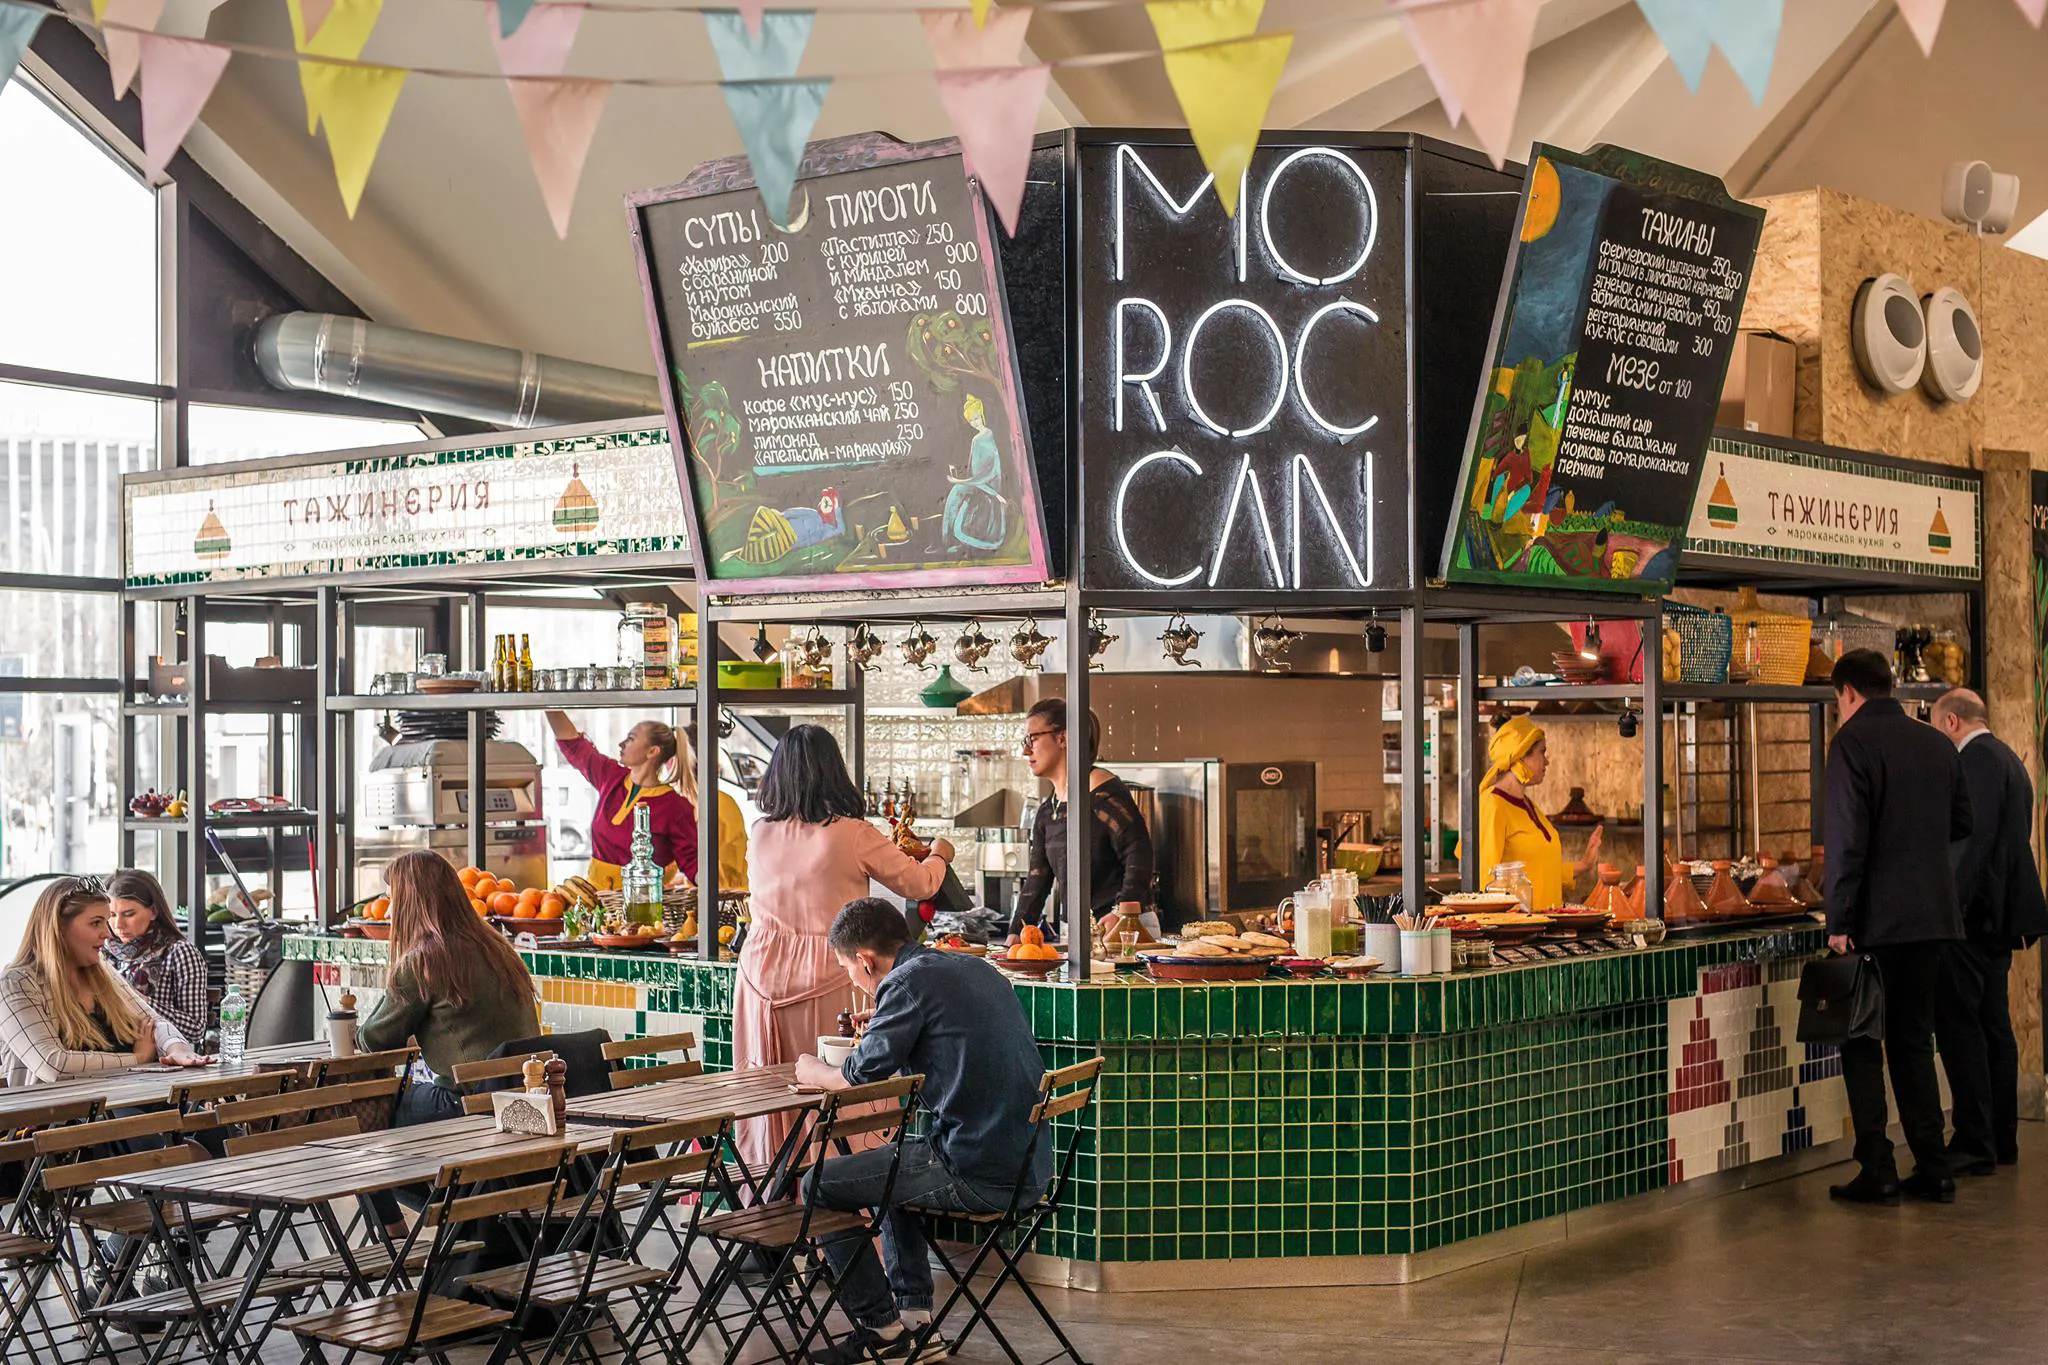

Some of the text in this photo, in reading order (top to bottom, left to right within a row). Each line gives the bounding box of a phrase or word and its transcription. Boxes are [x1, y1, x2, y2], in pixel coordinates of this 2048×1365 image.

[825, 180, 937, 229] ПИРОГИ
[684, 209, 761, 249] СУПЫ
[925, 222, 953, 245] 250
[1641, 207, 1716, 257] ТАЖИНЫ
[760, 241, 789, 265] 200
[826, 241, 978, 271] с курицей 900
[1600, 239, 1731, 281] фермерский цыпленок 350
[682, 263, 778, 291] с бараниной
[829, 258, 930, 287] и миндалем
[933, 268, 962, 290] 150
[1593, 273, 1635, 296] ягненок
[1606, 258, 1639, 278] груши
[1645, 268, 1693, 292] лимонной
[1724, 269, 1743, 290] 650
[685, 284, 752, 306] и нутом
[838, 293, 987, 320] с яблоками 800
[1590, 288, 1654, 316] абрикосами
[1663, 305, 1703, 327] изюмом
[773, 310, 802, 331] 350
[1702, 298, 1721, 319] 450
[1587, 308, 1667, 337] вегетарианский
[1635, 334, 1680, 354] овощами
[1692, 335, 1714, 358] 300
[757, 342, 890, 389] НАПИТКИ
[1116, 297, 1379, 439] ROC
[887, 380, 914, 401] 150
[1572, 388, 1612, 409] хумус
[893, 401, 920, 420] 250
[1566, 404, 1654, 436] домашний сыр
[896, 423, 924, 441] 250
[1565, 424, 1678, 456] печеные баклажаны
[1560, 440, 1606, 463] морковь
[1557, 458, 1605, 480] перчики
[1116, 451, 1373, 590] CAN
[1786, 527, 1886, 550] марокканская кухня
